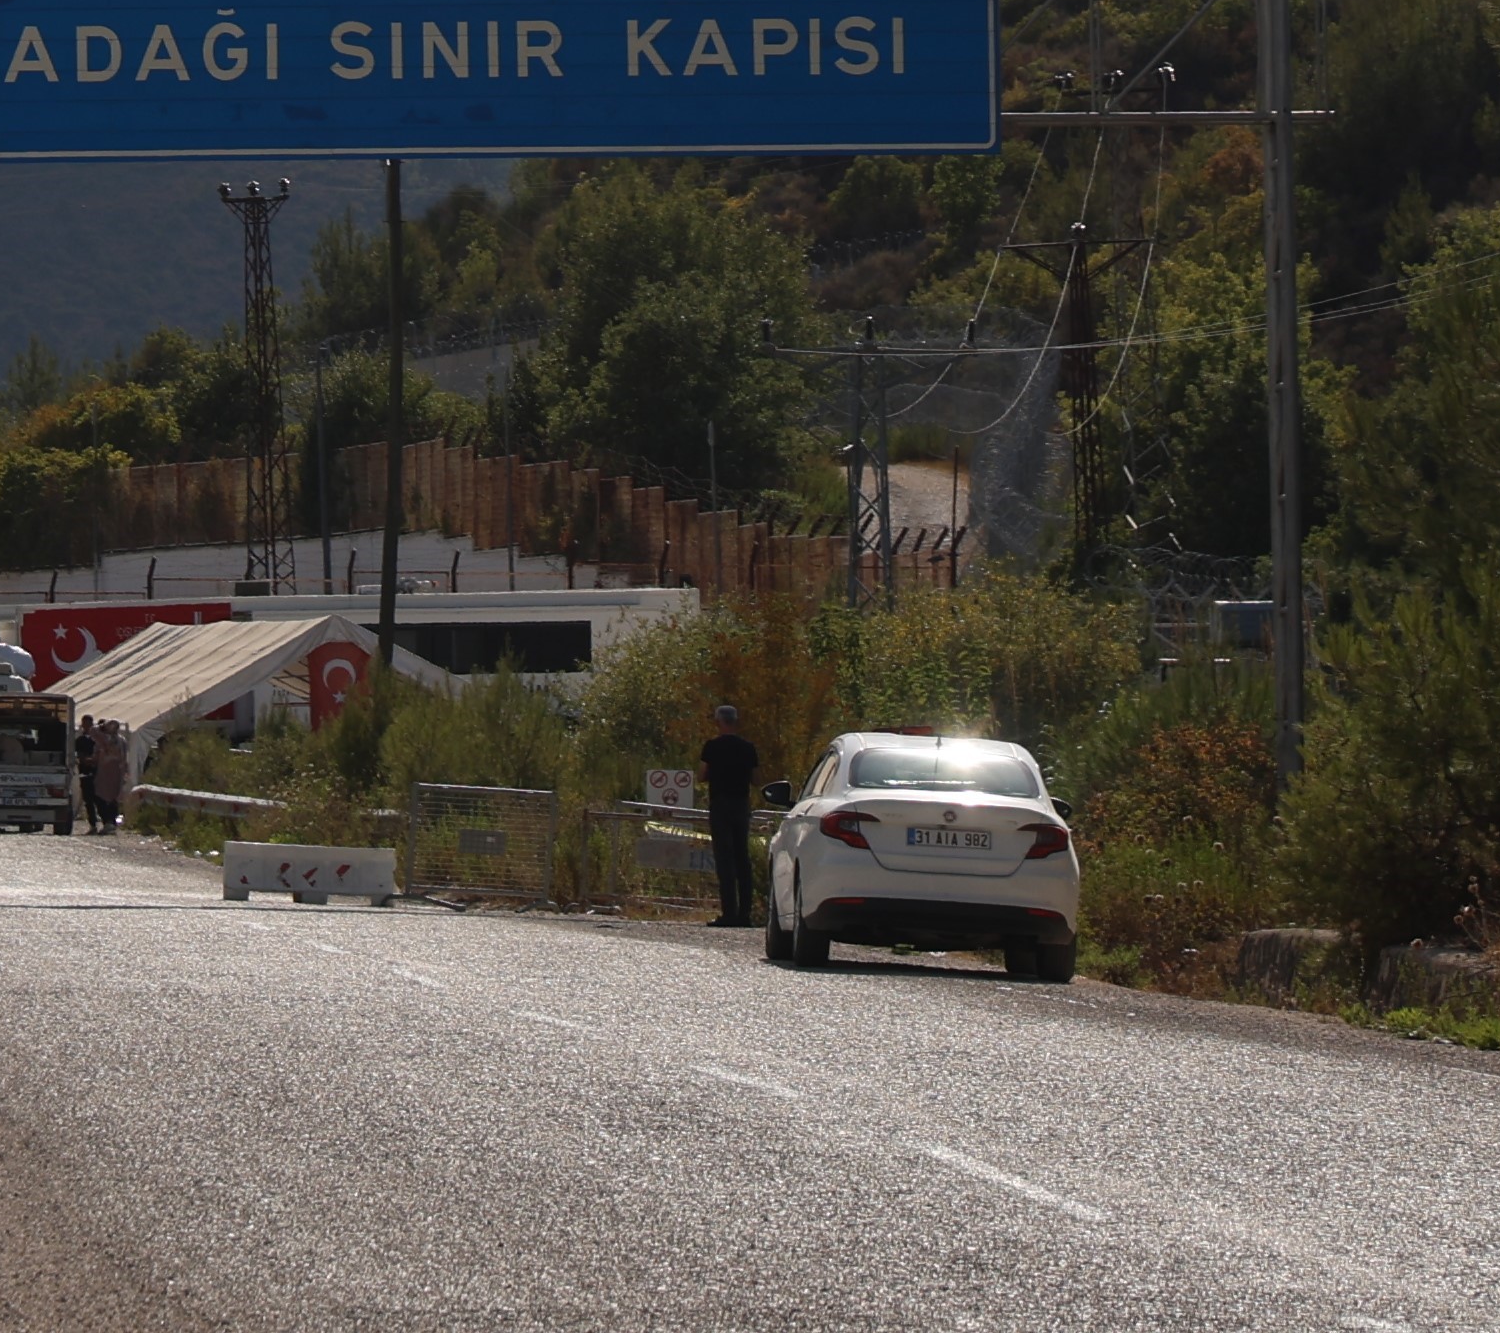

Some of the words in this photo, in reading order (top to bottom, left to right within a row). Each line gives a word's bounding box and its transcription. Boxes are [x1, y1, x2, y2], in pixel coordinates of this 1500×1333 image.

[330, 19, 564, 81] SINIR
[625, 16, 908, 77] KAPISI
[915, 830, 930, 844] 31
[935, 832, 958, 846] AIA
[964, 833, 988, 848] 982
